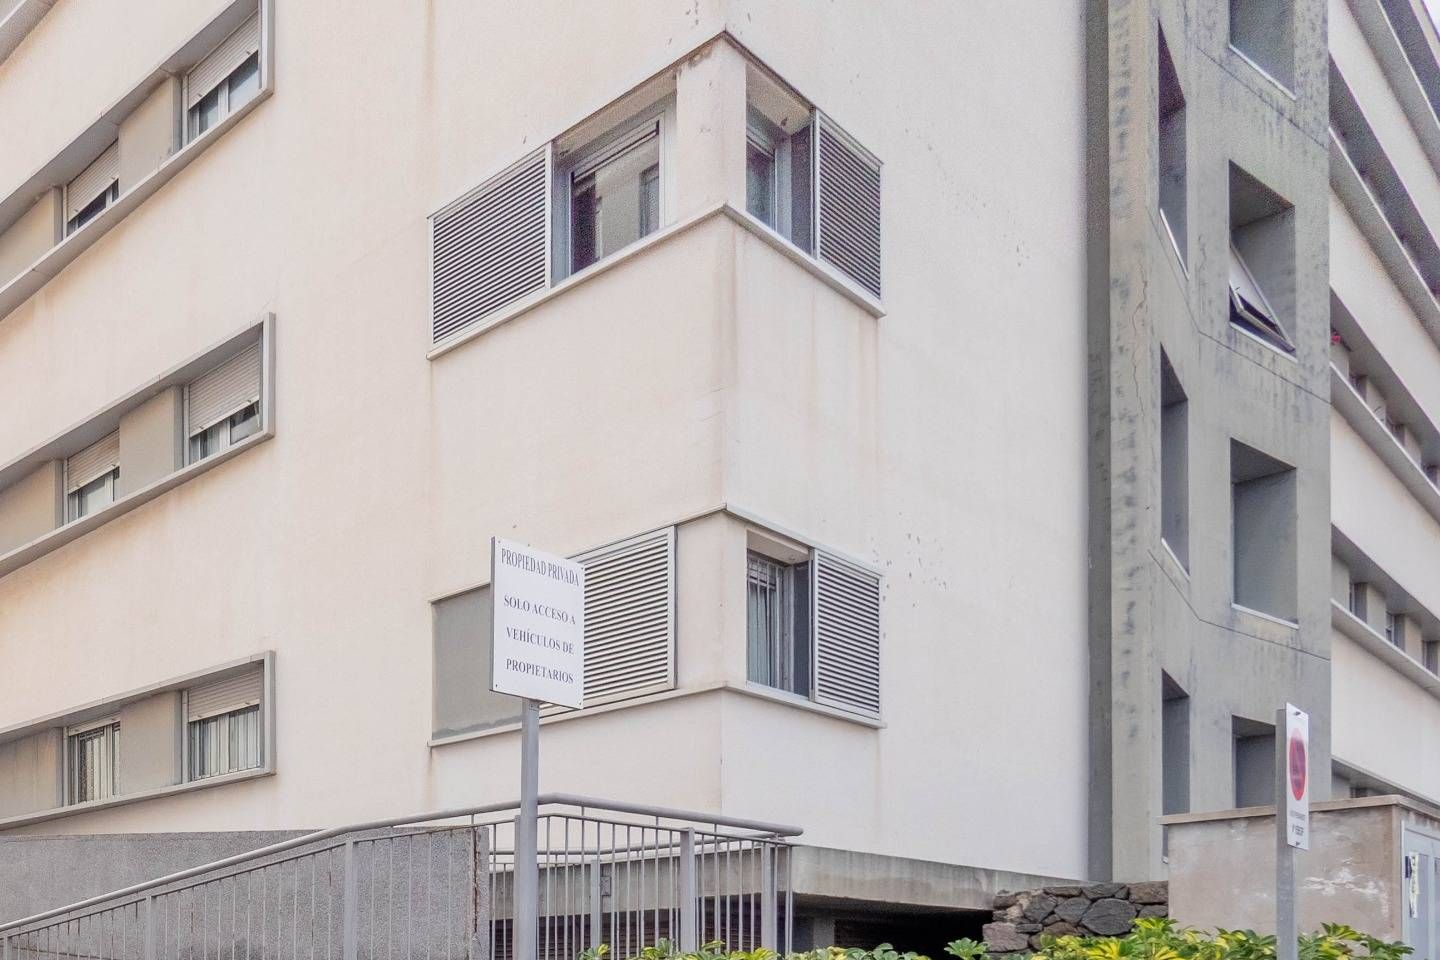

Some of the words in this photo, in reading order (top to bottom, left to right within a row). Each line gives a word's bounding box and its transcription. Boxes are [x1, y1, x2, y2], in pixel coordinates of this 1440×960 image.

[501, 548, 547, 576] PROPIEDAD
[548, 563, 580, 587] PRIVADA
[503, 594, 530, 612] SOLO
[532, 602, 569, 623] ACCESO
[569, 615, 576, 625] A
[506, 627, 561, 651] VEHÍCULOS
[562, 641, 574, 655] DE
[506, 658, 574, 684] PROPIETARIOS
